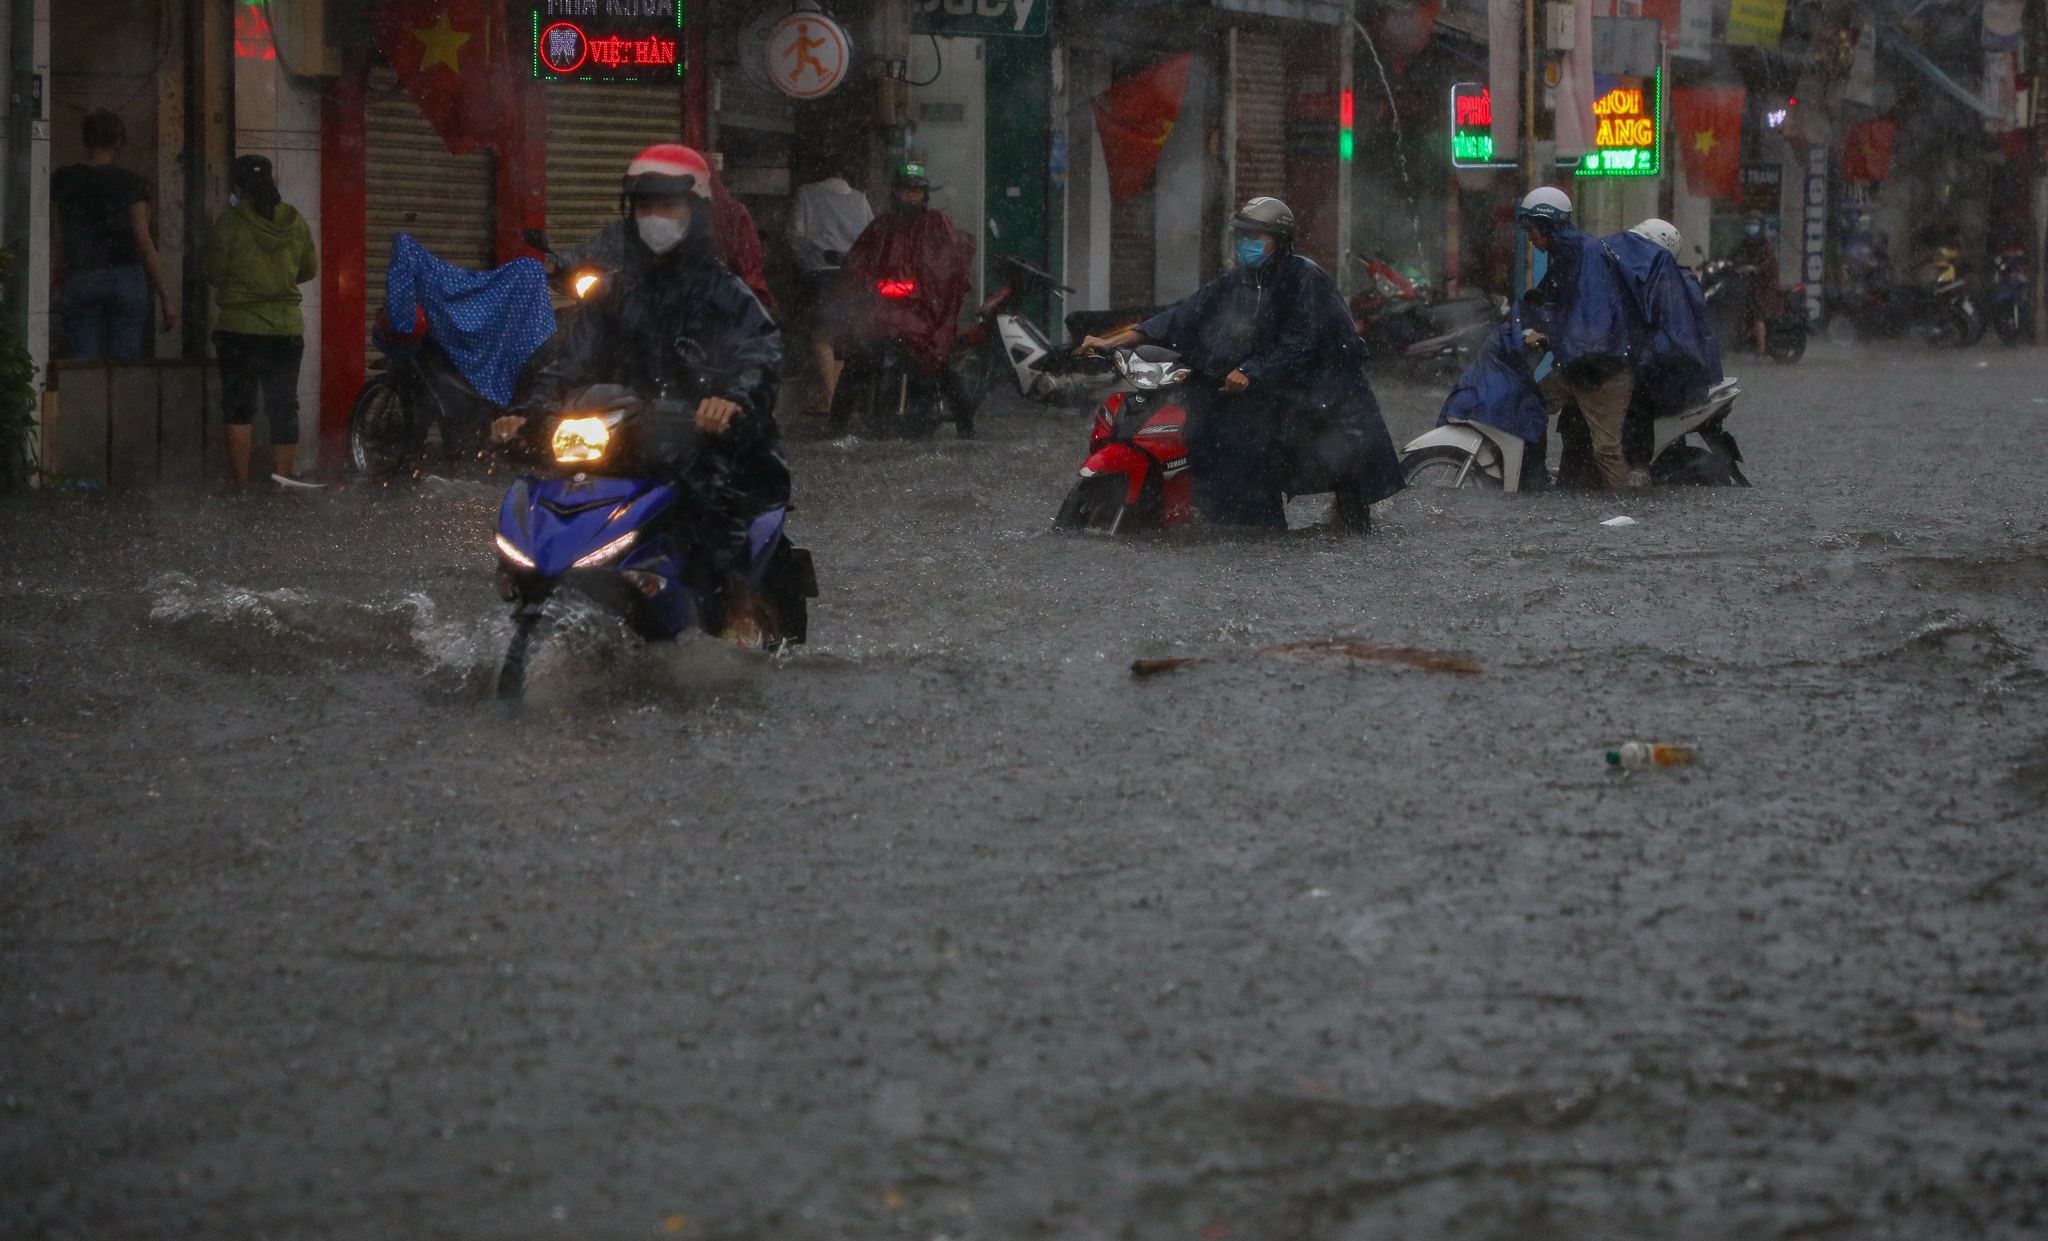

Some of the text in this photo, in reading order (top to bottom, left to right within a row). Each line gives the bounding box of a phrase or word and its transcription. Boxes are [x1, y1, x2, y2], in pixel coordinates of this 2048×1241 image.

[588, 35, 676, 68] VIỆT HÀN
[1638, 150, 1651, 169] 2
[1166, 458, 1187, 469] YAMAHA
